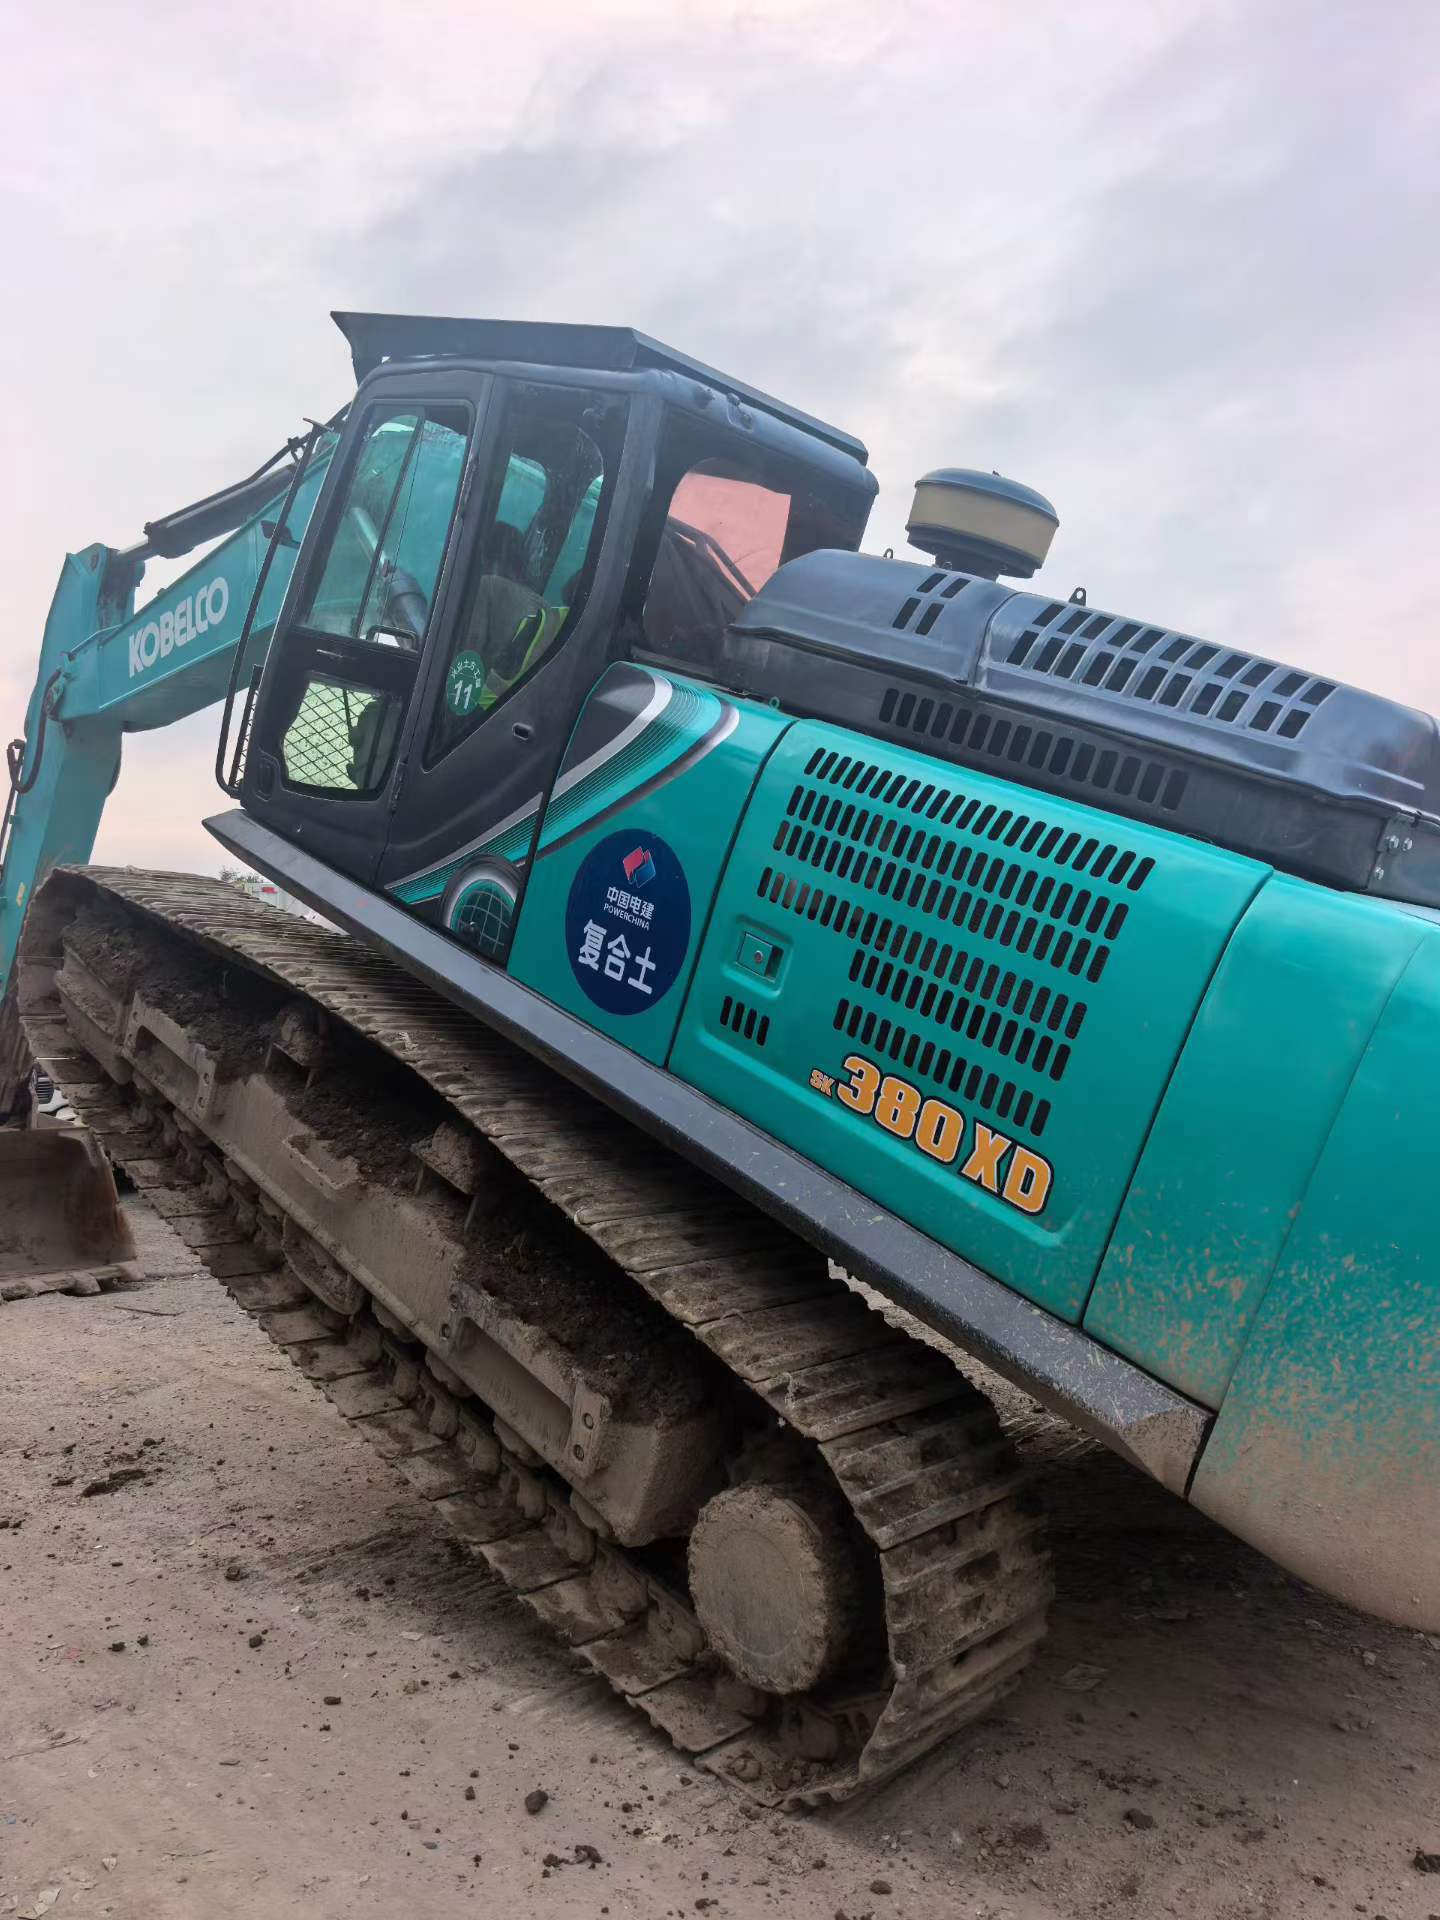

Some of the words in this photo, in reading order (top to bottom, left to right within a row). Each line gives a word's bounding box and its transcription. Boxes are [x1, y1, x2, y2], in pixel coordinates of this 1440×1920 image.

[128, 576, 229, 678] KOBELCO
[454, 680, 473, 710] 11
[603, 902, 650, 931] POWERCHINA
[606, 886, 655, 920] 中国电建
[577, 919, 657, 995] 复合土
